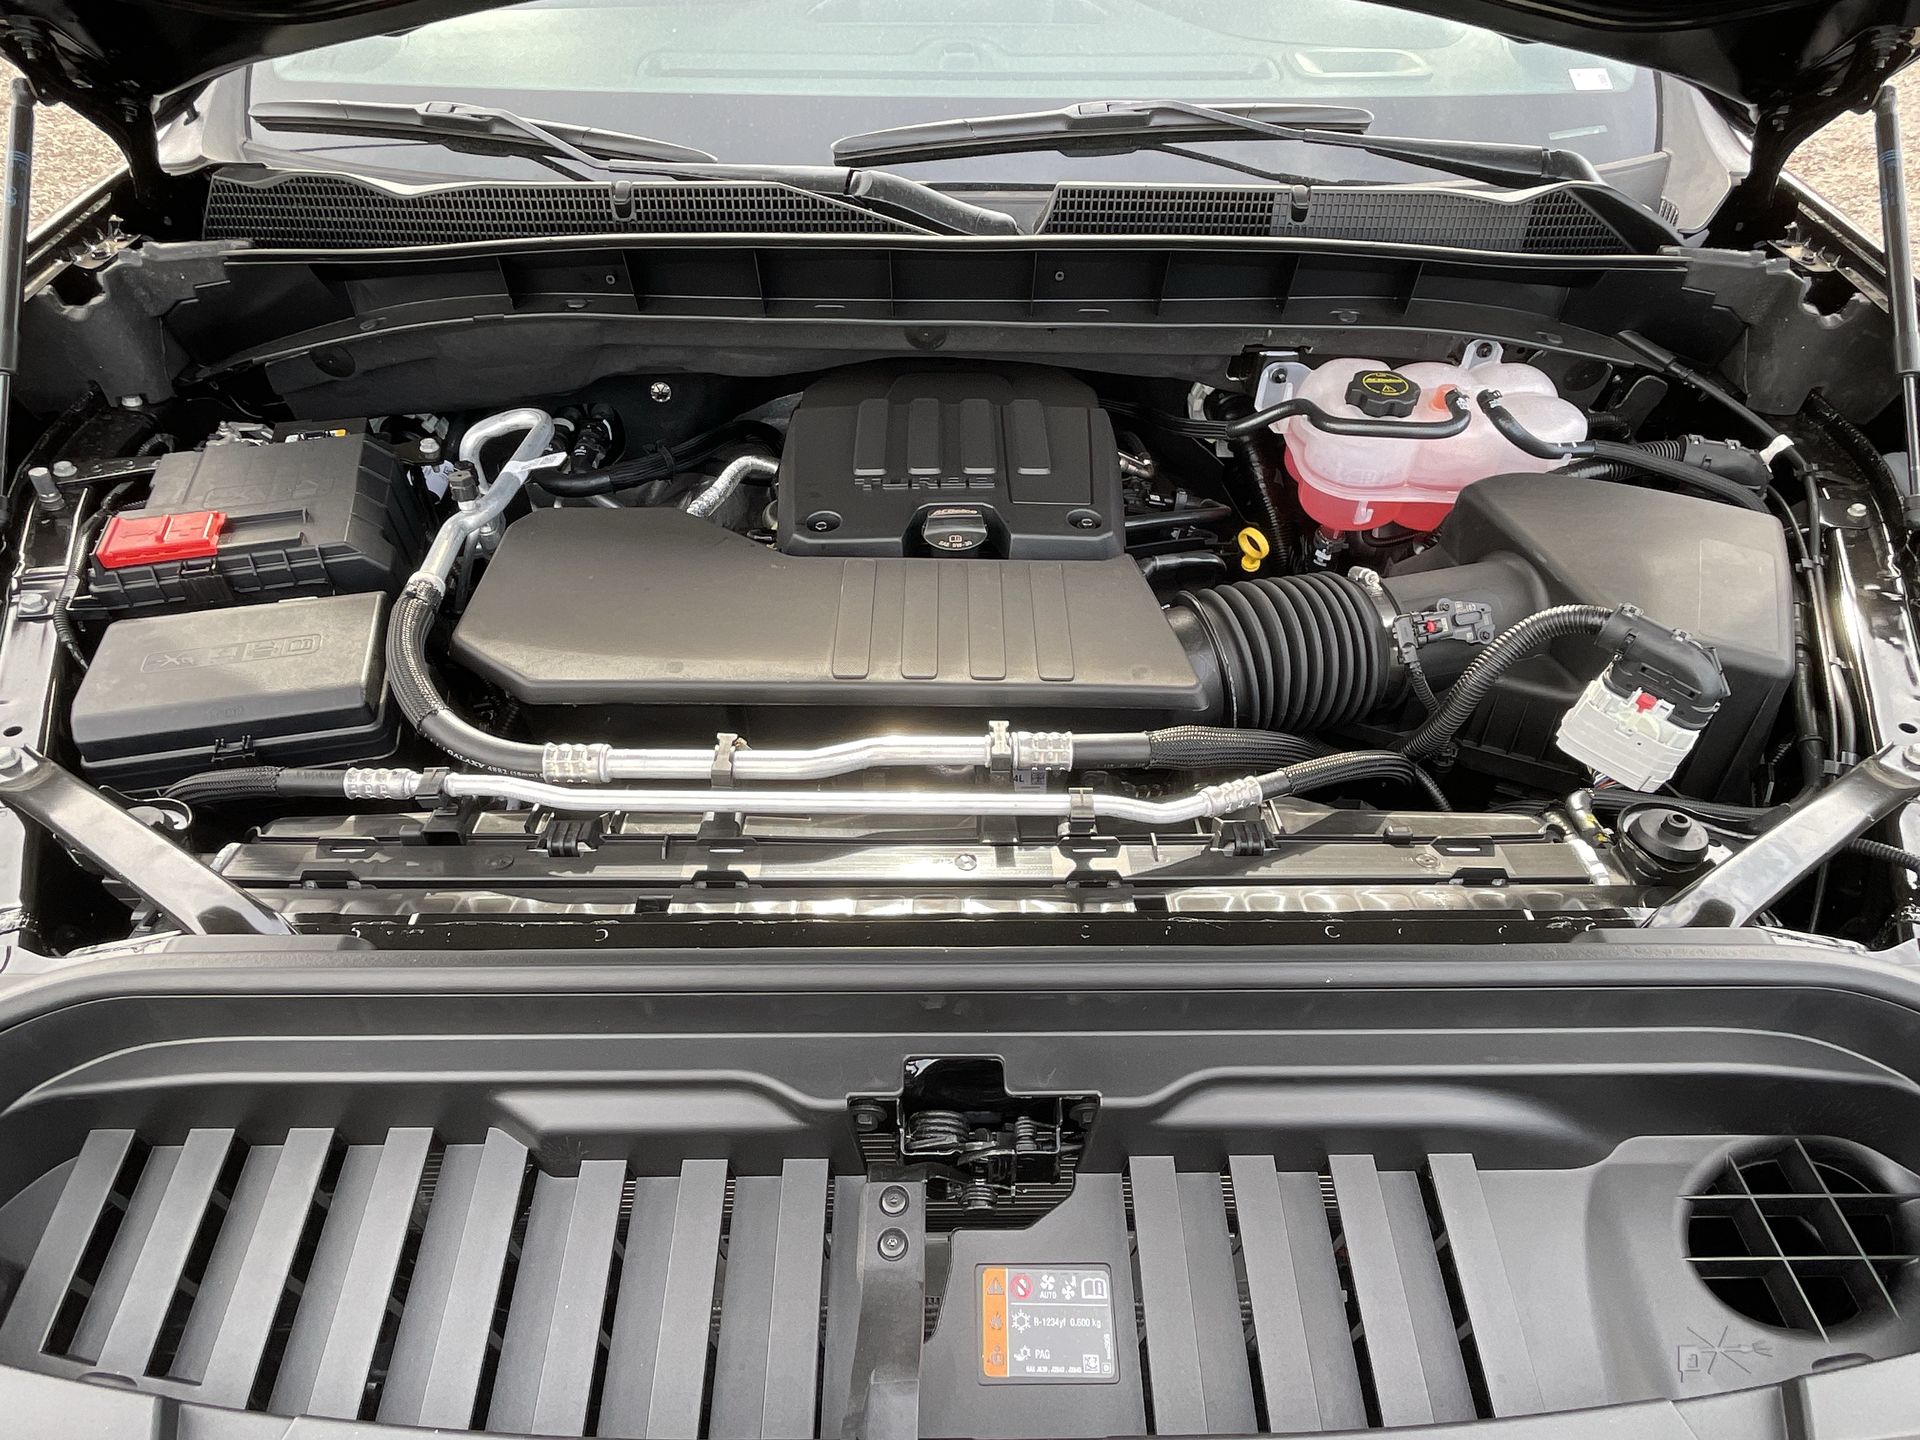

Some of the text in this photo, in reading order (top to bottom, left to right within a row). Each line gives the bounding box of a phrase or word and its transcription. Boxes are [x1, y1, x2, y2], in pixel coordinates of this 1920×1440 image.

[854, 477, 995, 491] TURBO
[446, 749, 486, 769] GALAXY
[1039, 1291, 1057, 1299] AUTO
[1033, 1317, 1102, 1328] R-1234yf 0.600 kg
[1034, 1349, 1050, 1359] PAG
